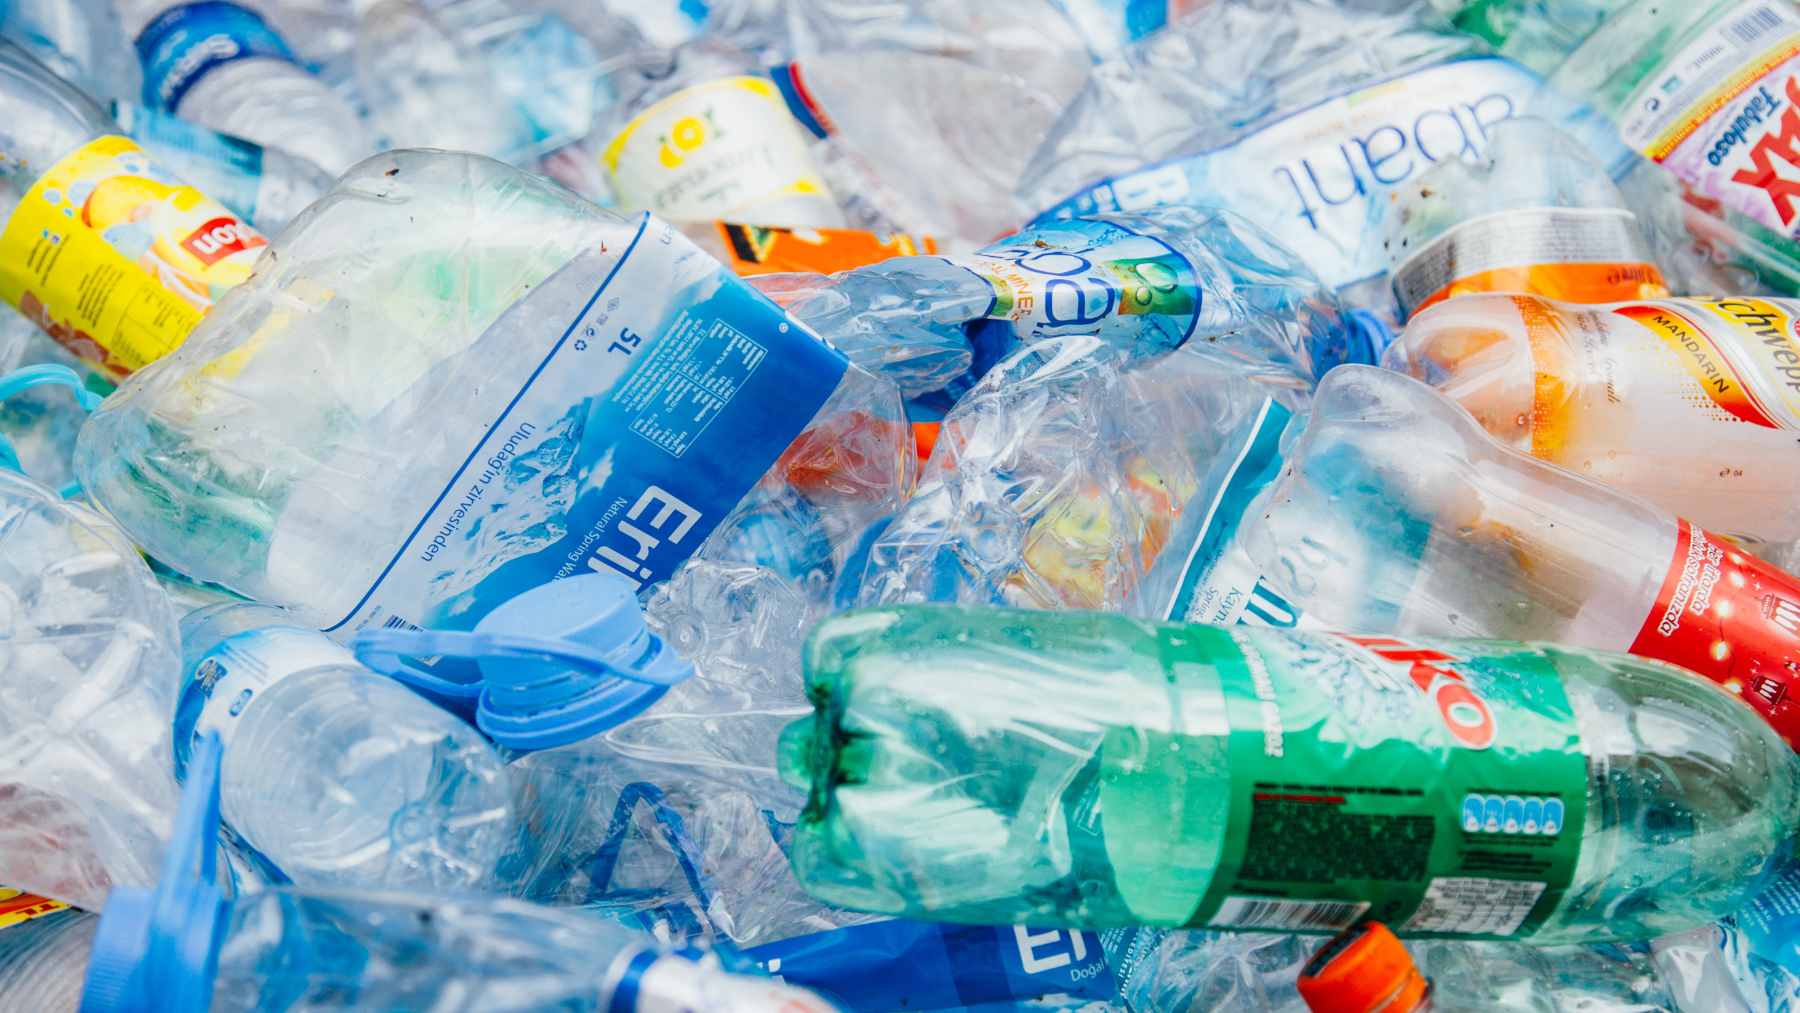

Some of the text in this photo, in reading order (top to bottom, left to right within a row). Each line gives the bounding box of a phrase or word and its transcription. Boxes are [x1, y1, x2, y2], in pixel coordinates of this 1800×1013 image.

[607, 326, 641, 360] 5L
[1652, 315, 1731, 394] MANDARIN
[420, 482, 486, 564] zirvesinden
[593, 494, 627, 534] Natural
[567, 527, 600, 566] Spring
[1657, 555, 1702, 637] sofranızda
[1689, 561, 1722, 617] iftarda
